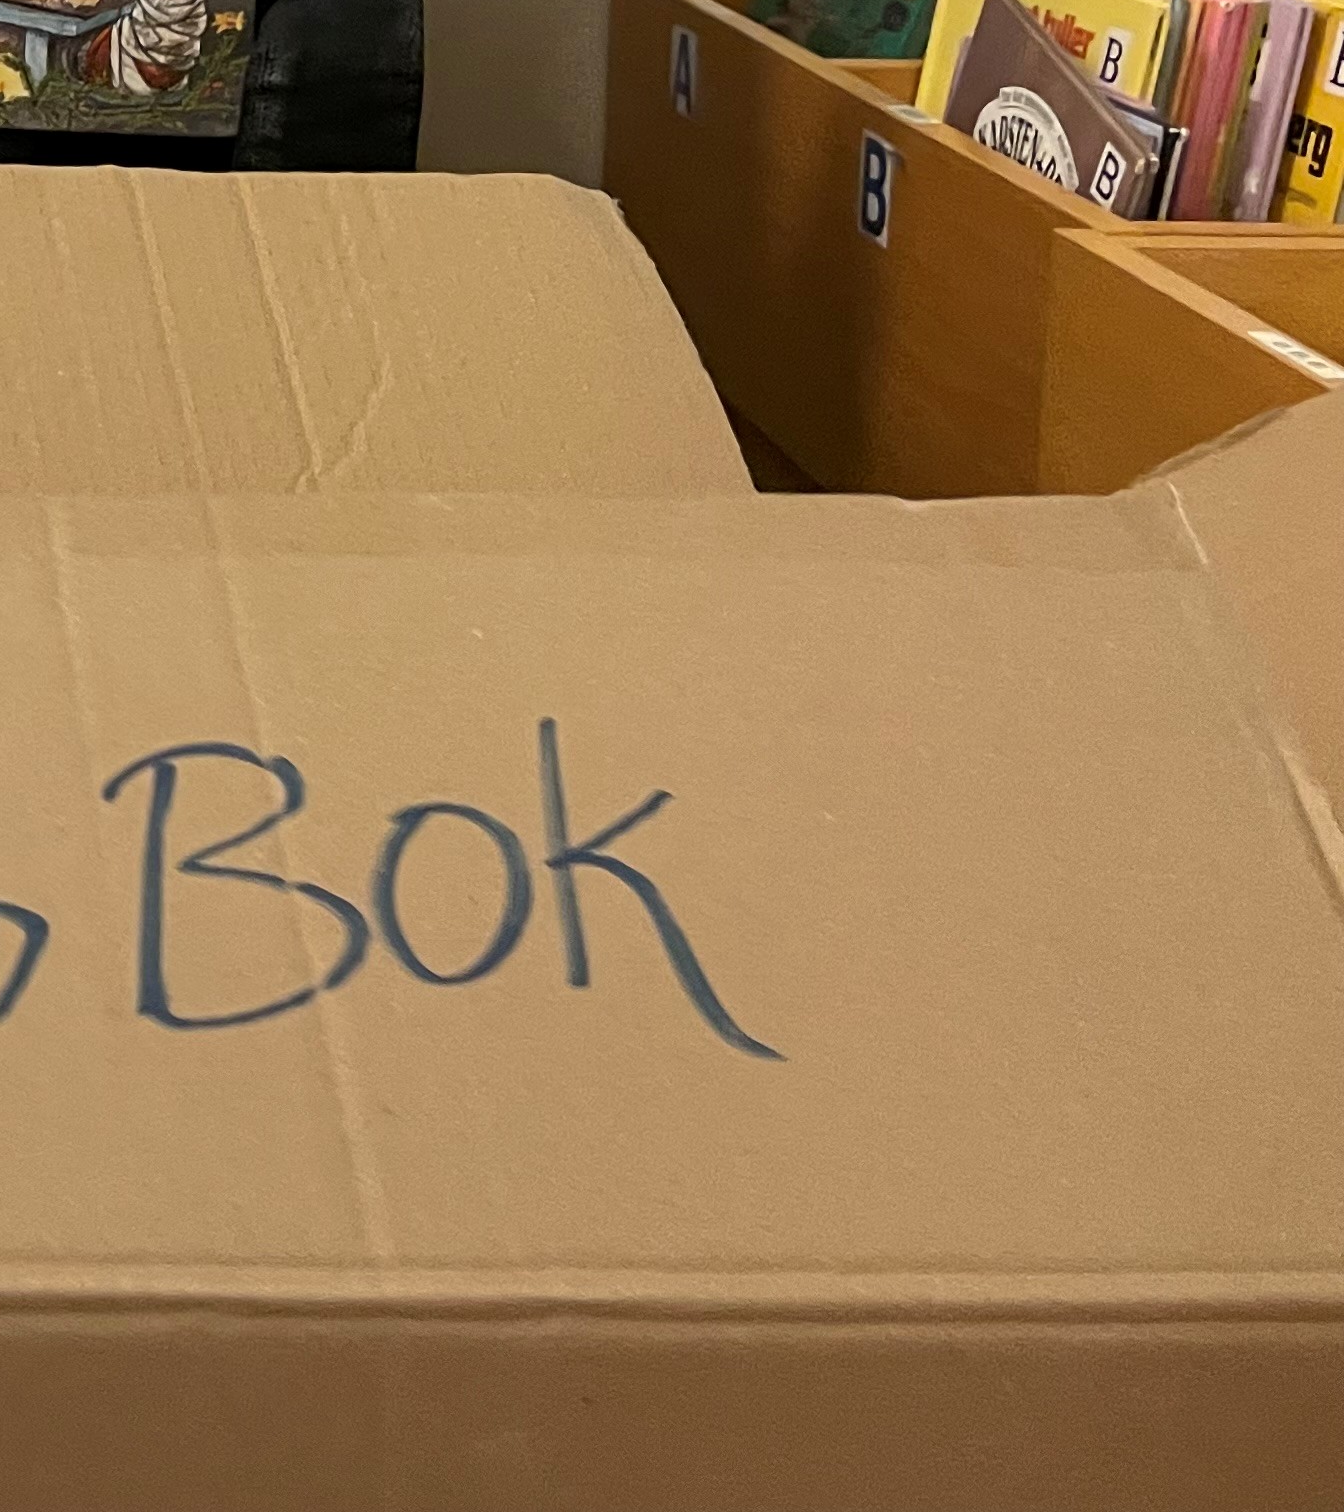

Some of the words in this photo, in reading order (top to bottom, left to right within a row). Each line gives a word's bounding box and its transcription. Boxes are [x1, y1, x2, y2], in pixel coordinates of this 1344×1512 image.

[673, 33, 692, 116] A
[1099, 36, 1123, 84] B
[863, 136, 887, 237] B
[1095, 151, 1120, 201] B
